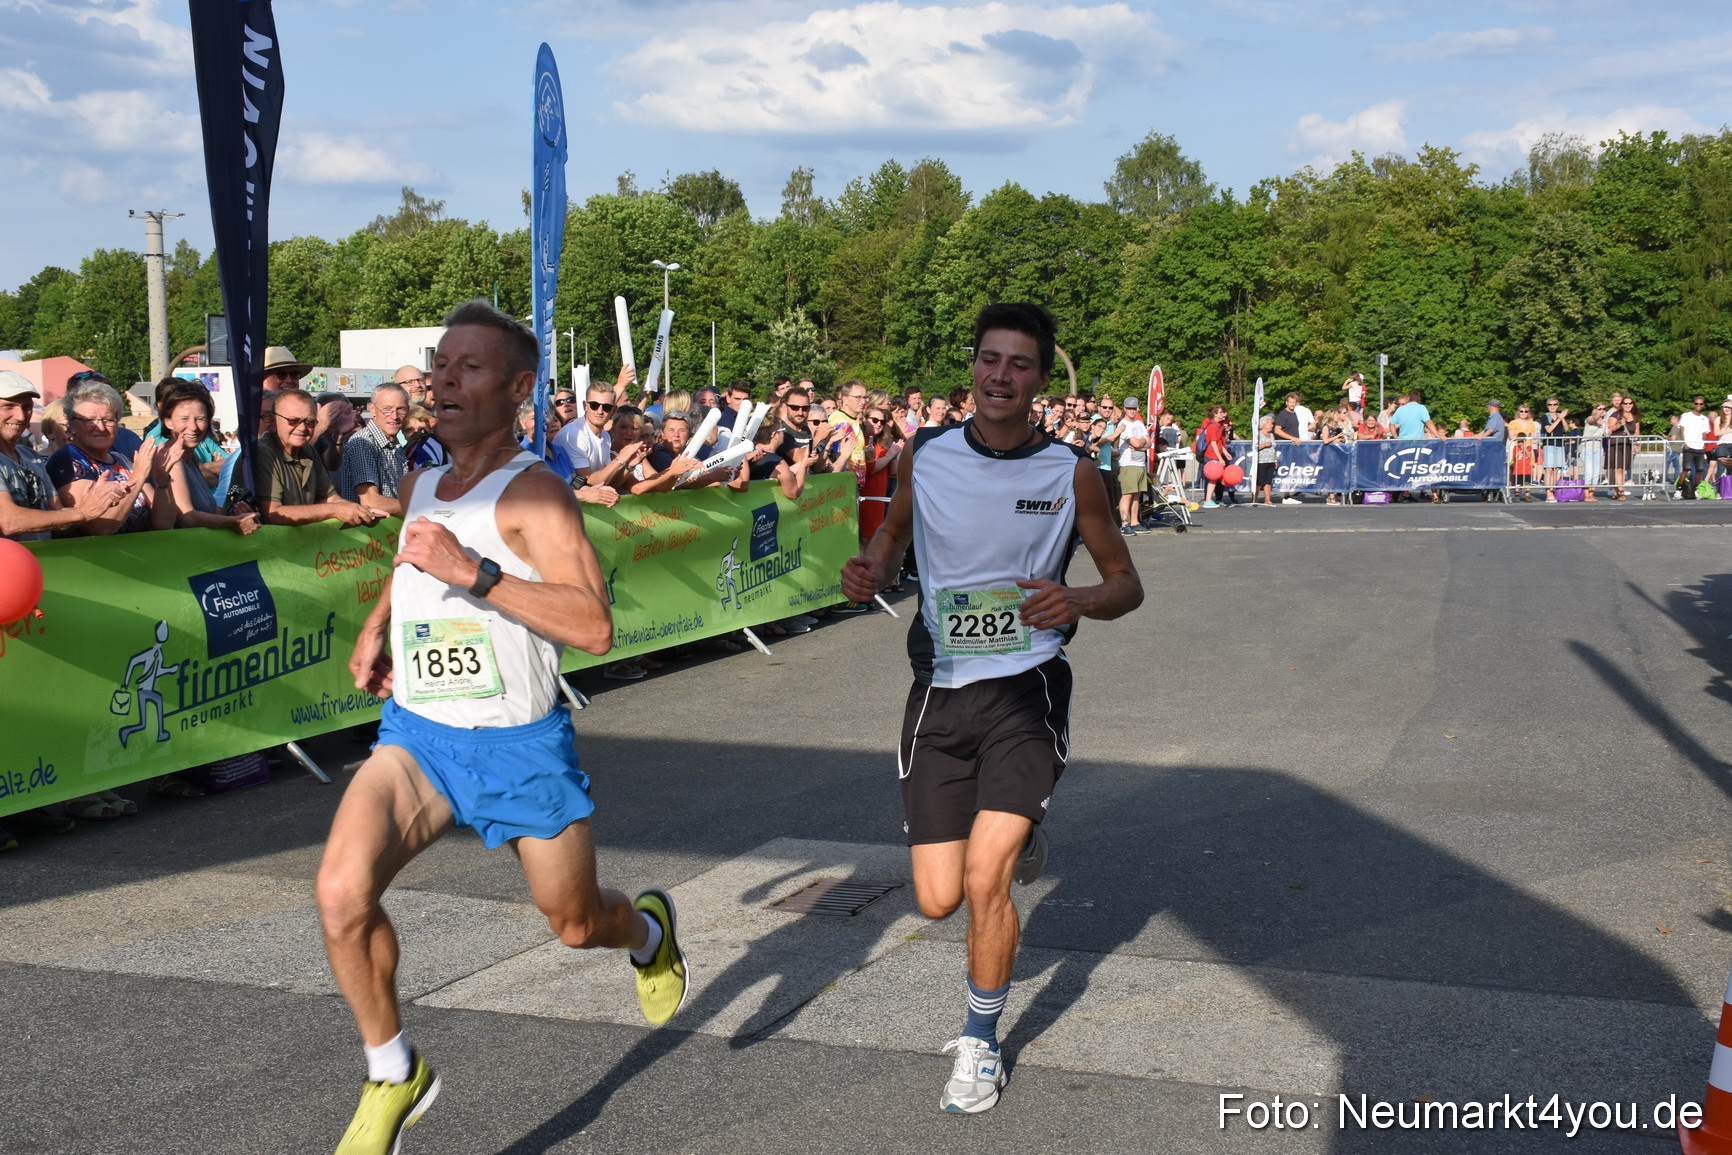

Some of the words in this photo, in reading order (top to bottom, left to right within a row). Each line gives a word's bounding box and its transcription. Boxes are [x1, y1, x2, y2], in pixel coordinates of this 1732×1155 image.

[1277, 462, 1324, 477] cher
[1400, 460, 1475, 475] Fischer
[1407, 475, 1468, 483] AUTOMOBILE
[1015, 499, 1052, 511] swn
[614, 509, 656, 541] Gesunde
[756, 520, 776, 534] Fischer
[315, 532, 386, 578] Gesunde
[632, 534, 665, 563] laufen
[740, 537, 802, 591] firmenlauf
[213, 589, 259, 612] Fischer
[743, 583, 772, 605] neumarkt
[223, 602, 261, 620] AUTOMOBILE
[948, 611, 1016, 637] 2282
[988, 635, 1018, 643] Matthias
[177, 612, 335, 709] firmenlauf
[412, 646, 481, 679] 1853
[181, 690, 253, 732] neumarkt
